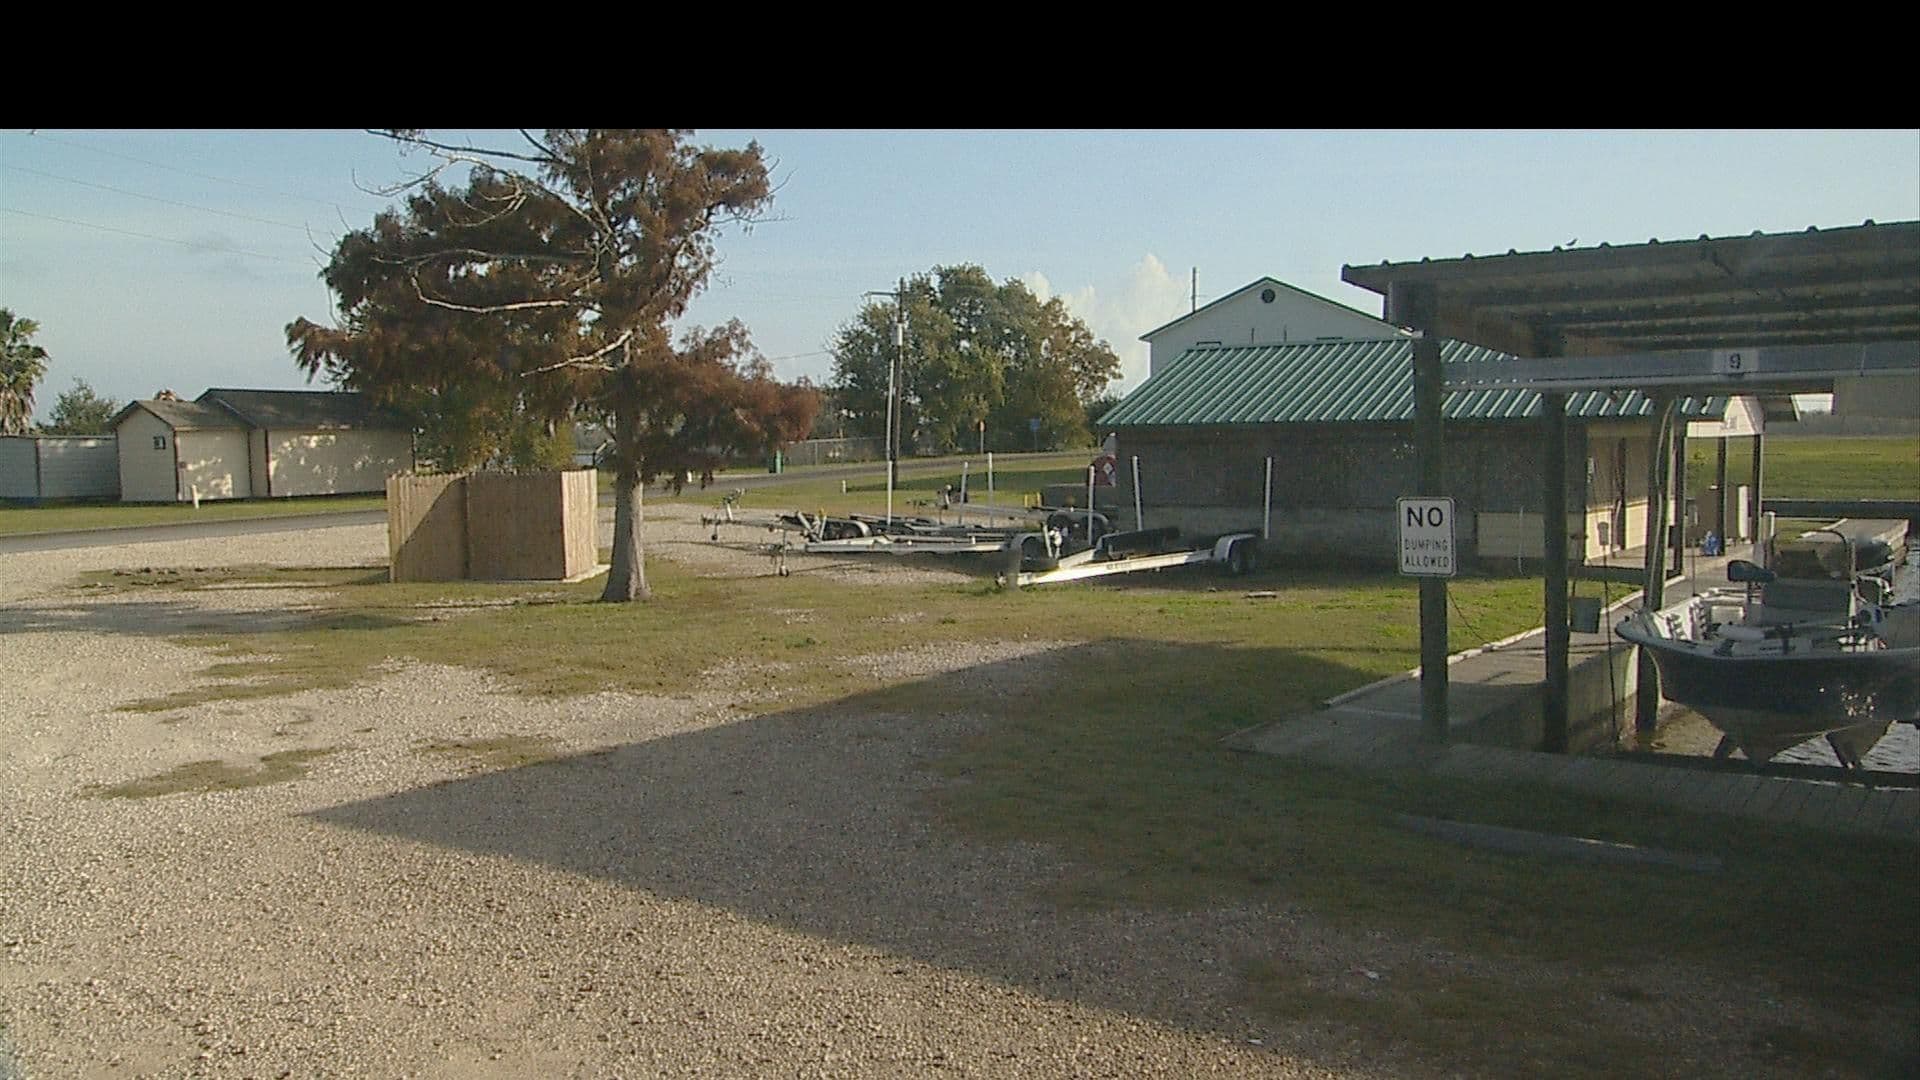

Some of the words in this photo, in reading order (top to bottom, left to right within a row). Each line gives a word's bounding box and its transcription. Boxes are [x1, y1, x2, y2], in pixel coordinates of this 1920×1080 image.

[1729, 352, 1741, 369] 9
[1406, 506, 1444, 528] NO
[1404, 538, 1449, 552] DUMPING
[1404, 556, 1450, 568] ALLOWED
